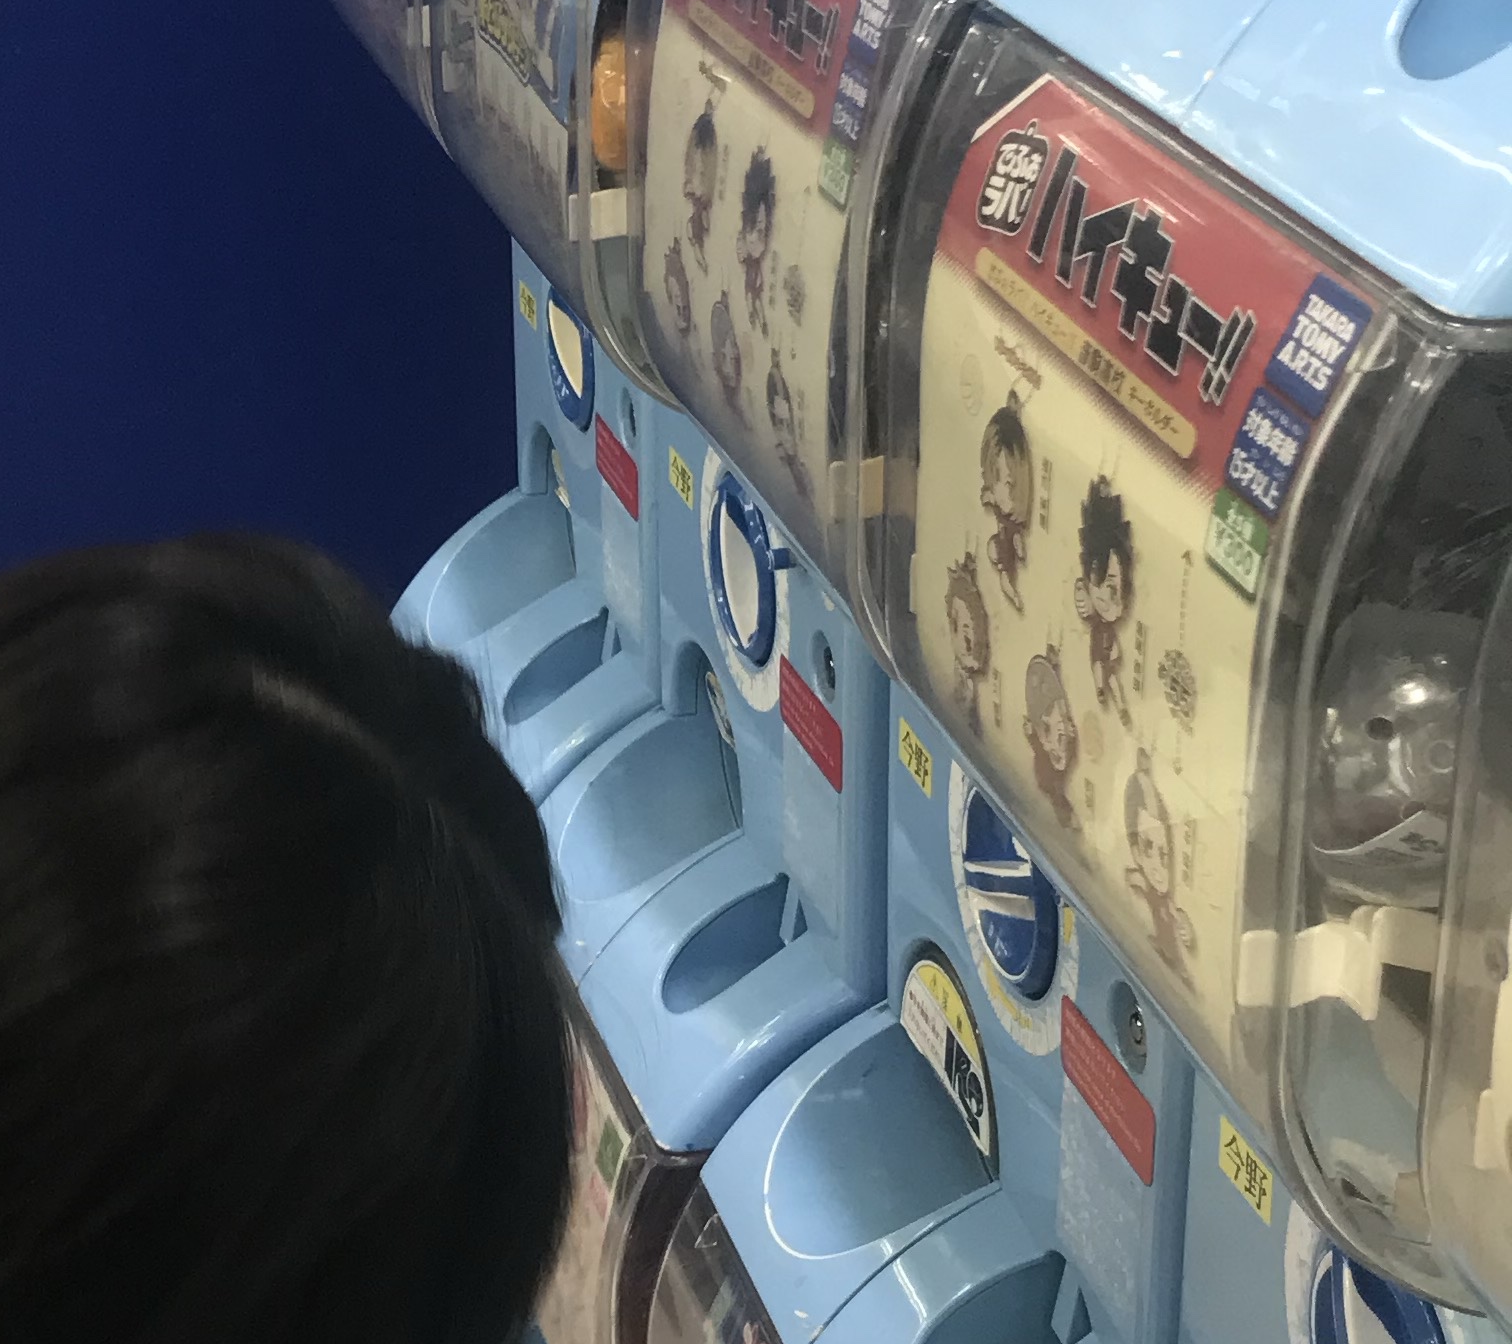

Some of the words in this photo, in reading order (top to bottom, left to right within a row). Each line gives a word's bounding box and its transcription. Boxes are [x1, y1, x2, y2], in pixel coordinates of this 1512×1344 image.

[1026, 143, 1258, 407] ハイキュー!!
[520, 284, 535, 324] 今野
[1308, 293, 1357, 343] TAKARA
[1291, 314, 1346, 364] TOMY
[1277, 339, 1333, 392] ARTS
[671, 454, 692, 504] 今野
[902, 731, 929, 788] 今野
[1226, 1136, 1266, 1209] 今野
